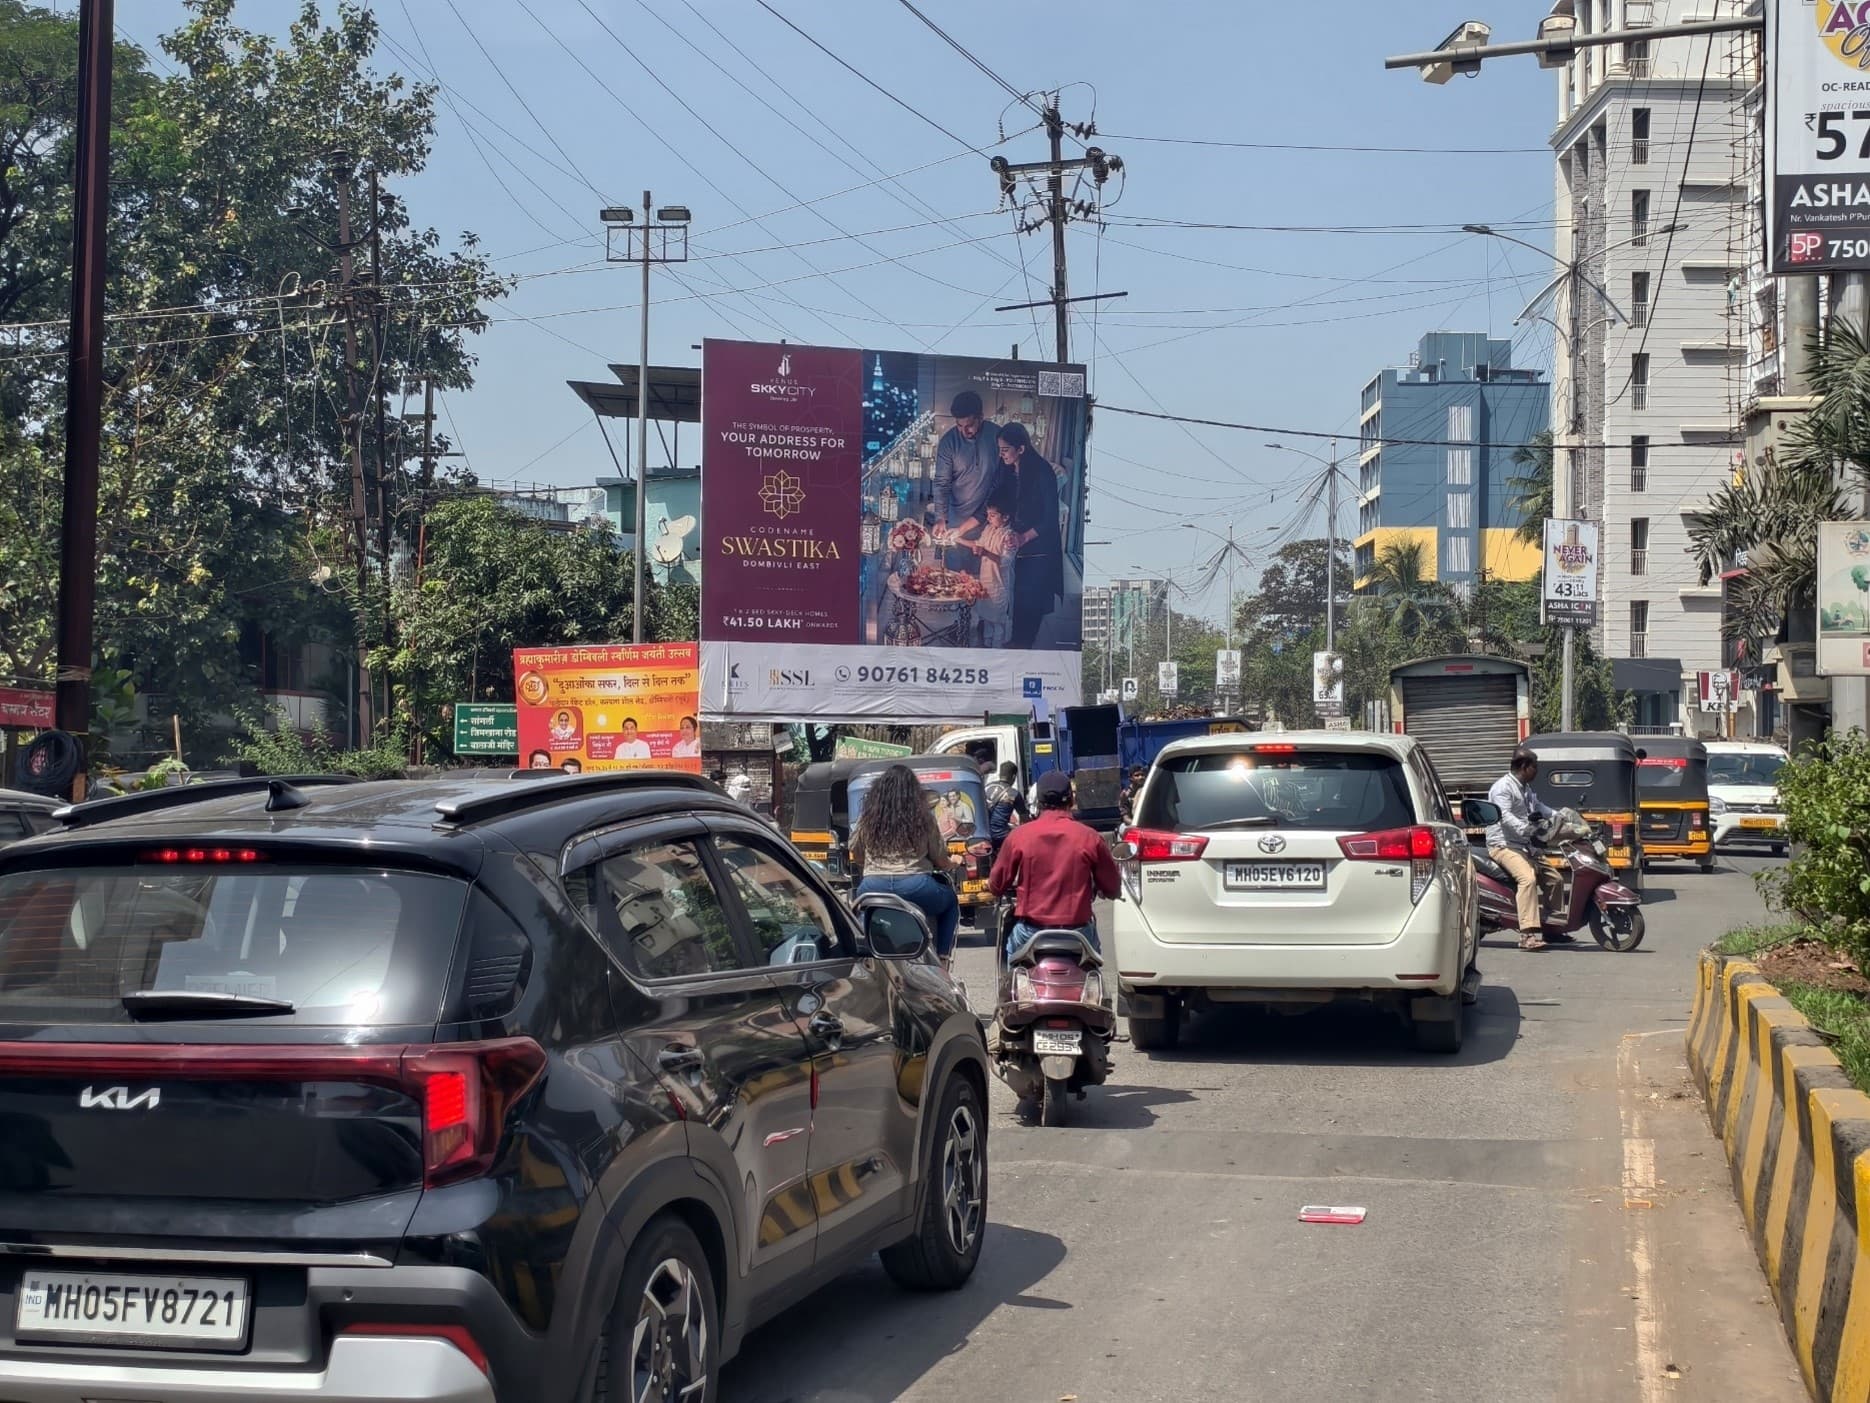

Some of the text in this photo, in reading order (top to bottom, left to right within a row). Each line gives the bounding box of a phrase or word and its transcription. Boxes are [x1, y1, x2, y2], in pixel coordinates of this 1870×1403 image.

[1790, 183, 1870, 208] ASHA
[1828, 240, 1870, 258] 750
[732, 422, 746, 430] THE
[749, 423, 777, 431] SYMBOL
[721, 432, 845, 448] YOUR ADDRESS FOR
[746, 446, 821, 460] TOMORROW
[750, 526, 814, 536] CODENAME
[721, 536, 840, 560] SWASTIKA
[1554, 544, 1587, 555] NEVER
[743, 560, 820, 570] DOMBIVLI EAST
[1559, 554, 1592, 564] AGAIN
[723, 616, 764, 628] ₹41.50
[624, 675, 640, 688] दिल
[642, 674, 650, 688] से
[652, 674, 668, 687] दिल
[858, 666, 989, 684] 90761 84258
[1235, 867, 1320, 882] MH05EV6120
[80, 1086, 160, 1110] KIA
[44, 1283, 235, 1326] MH05FV8721
